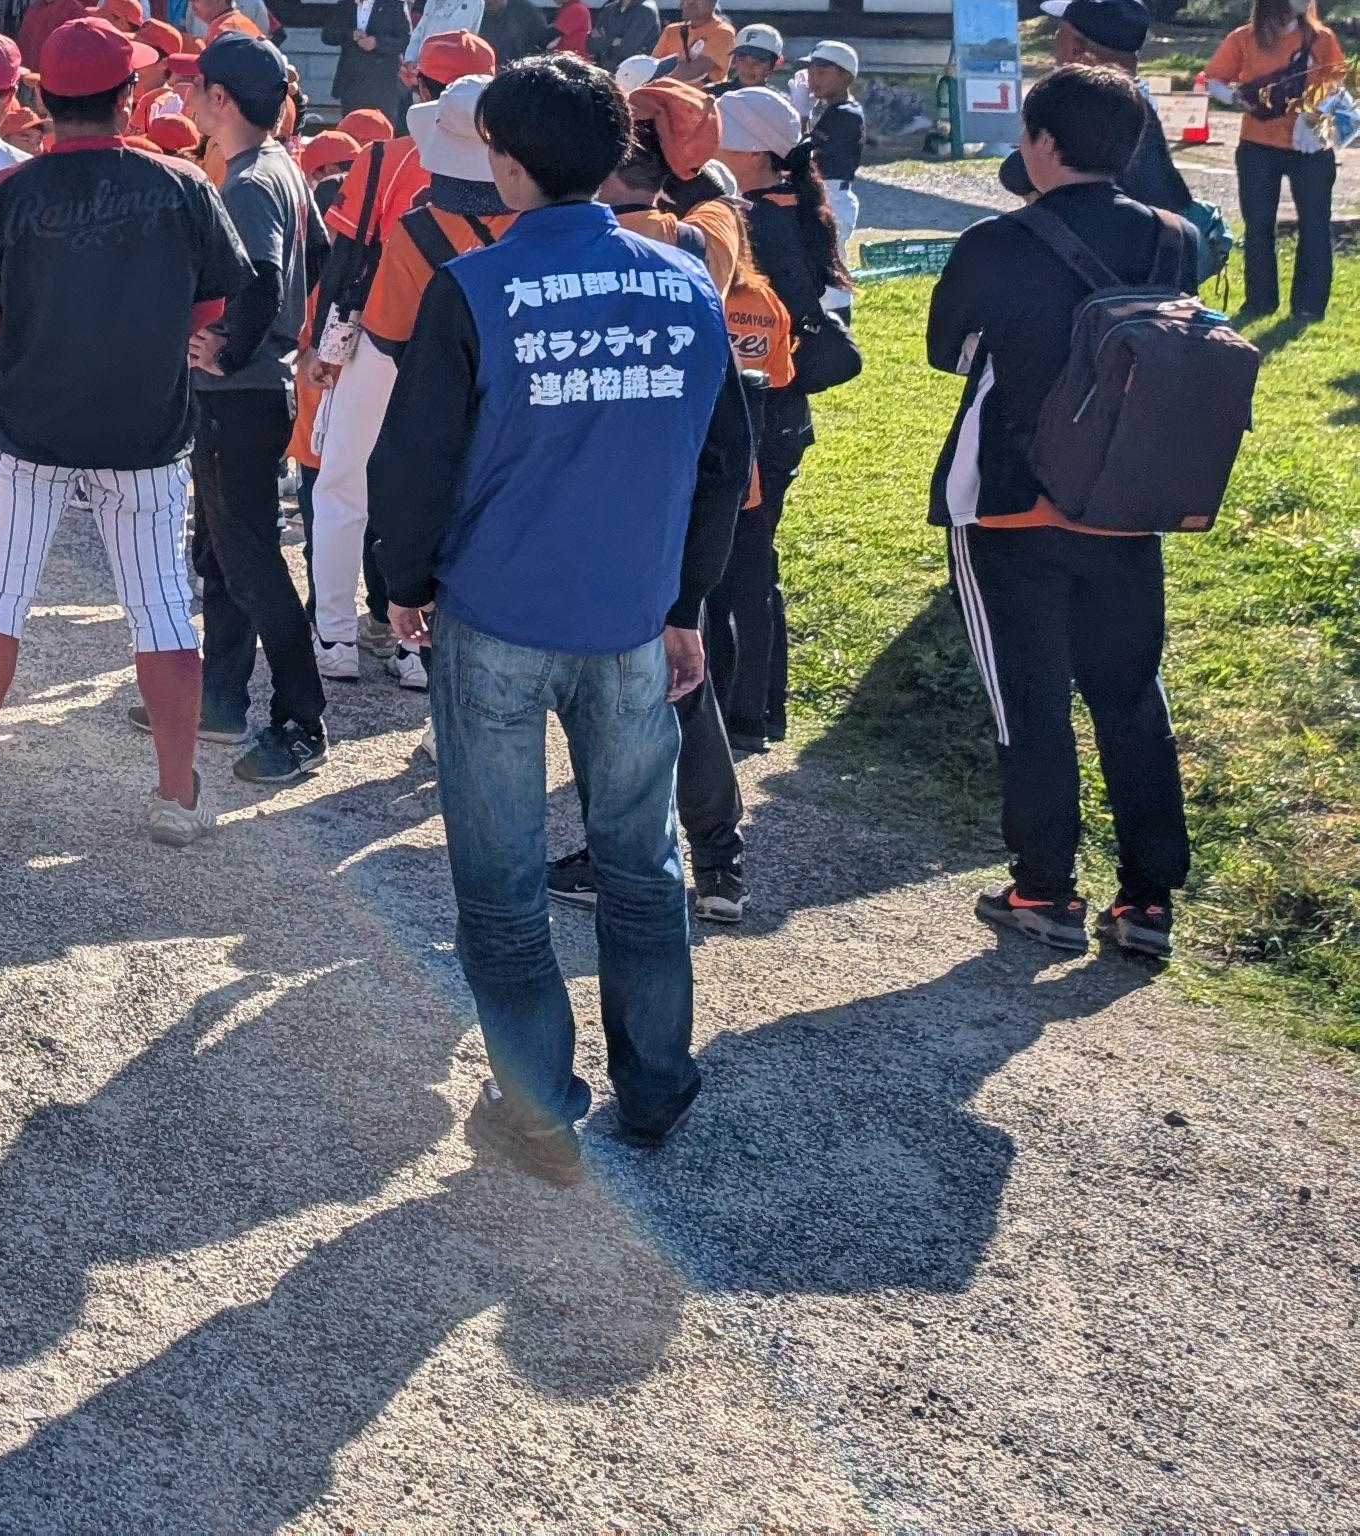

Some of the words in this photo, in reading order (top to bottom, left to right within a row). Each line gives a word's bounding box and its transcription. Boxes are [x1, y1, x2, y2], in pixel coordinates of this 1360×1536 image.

[504, 268, 694, 318] 大和郡山市
[513, 325, 696, 364] ボランティア
[529, 364, 686, 407] 連絡協議会
